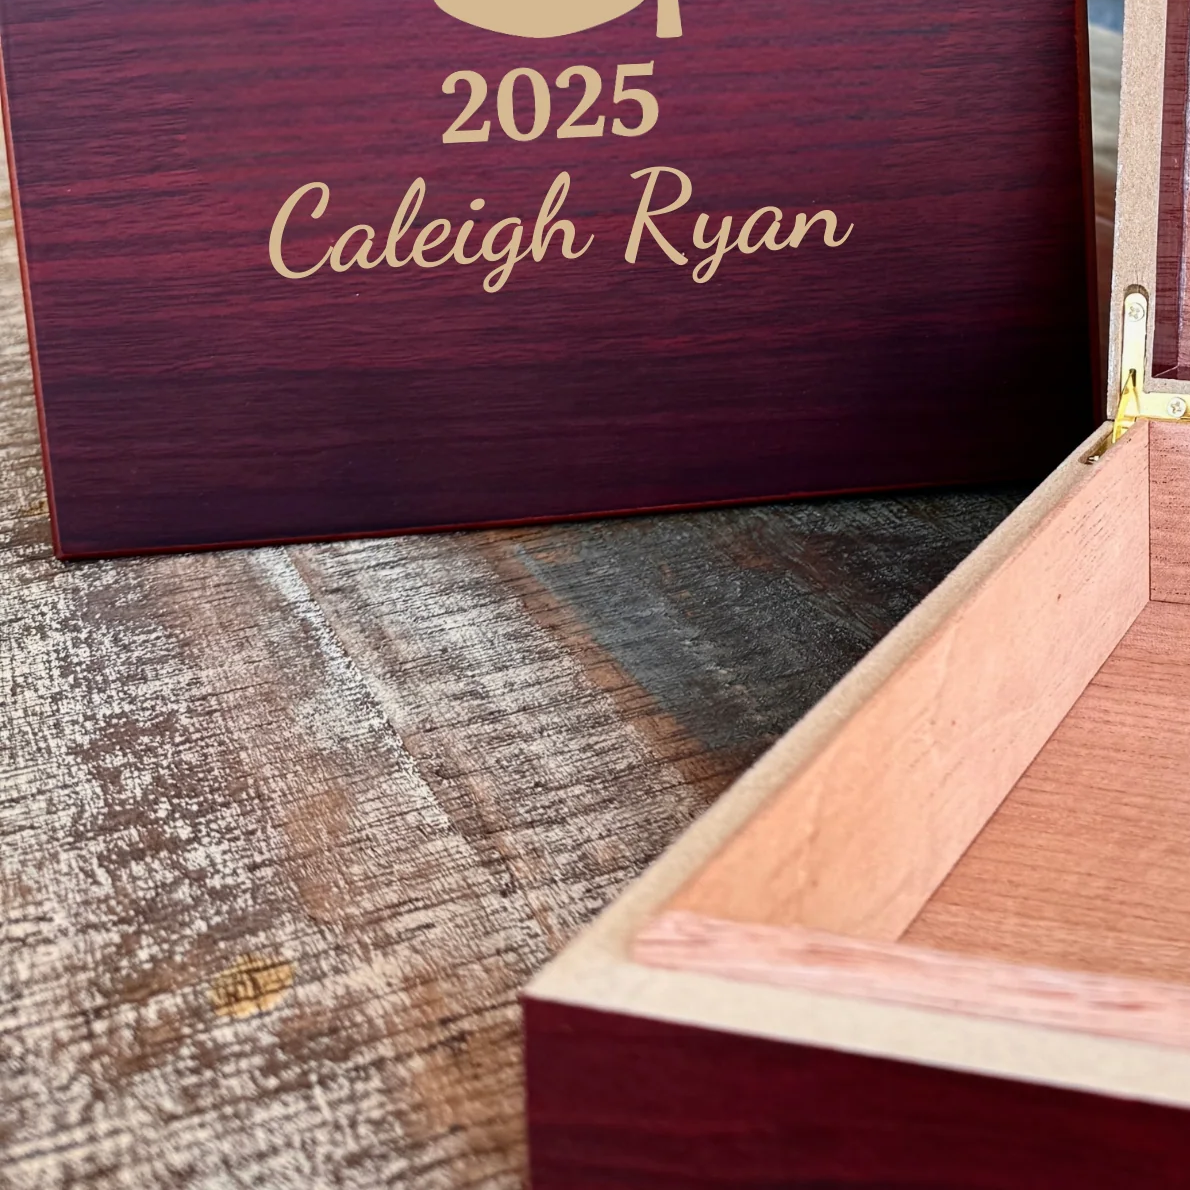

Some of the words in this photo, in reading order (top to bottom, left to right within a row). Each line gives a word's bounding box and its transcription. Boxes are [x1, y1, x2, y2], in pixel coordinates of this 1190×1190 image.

[441, 60, 659, 144] 2025
[268, 171, 595, 293] Caleigh
[624, 166, 855, 284] Ryan
